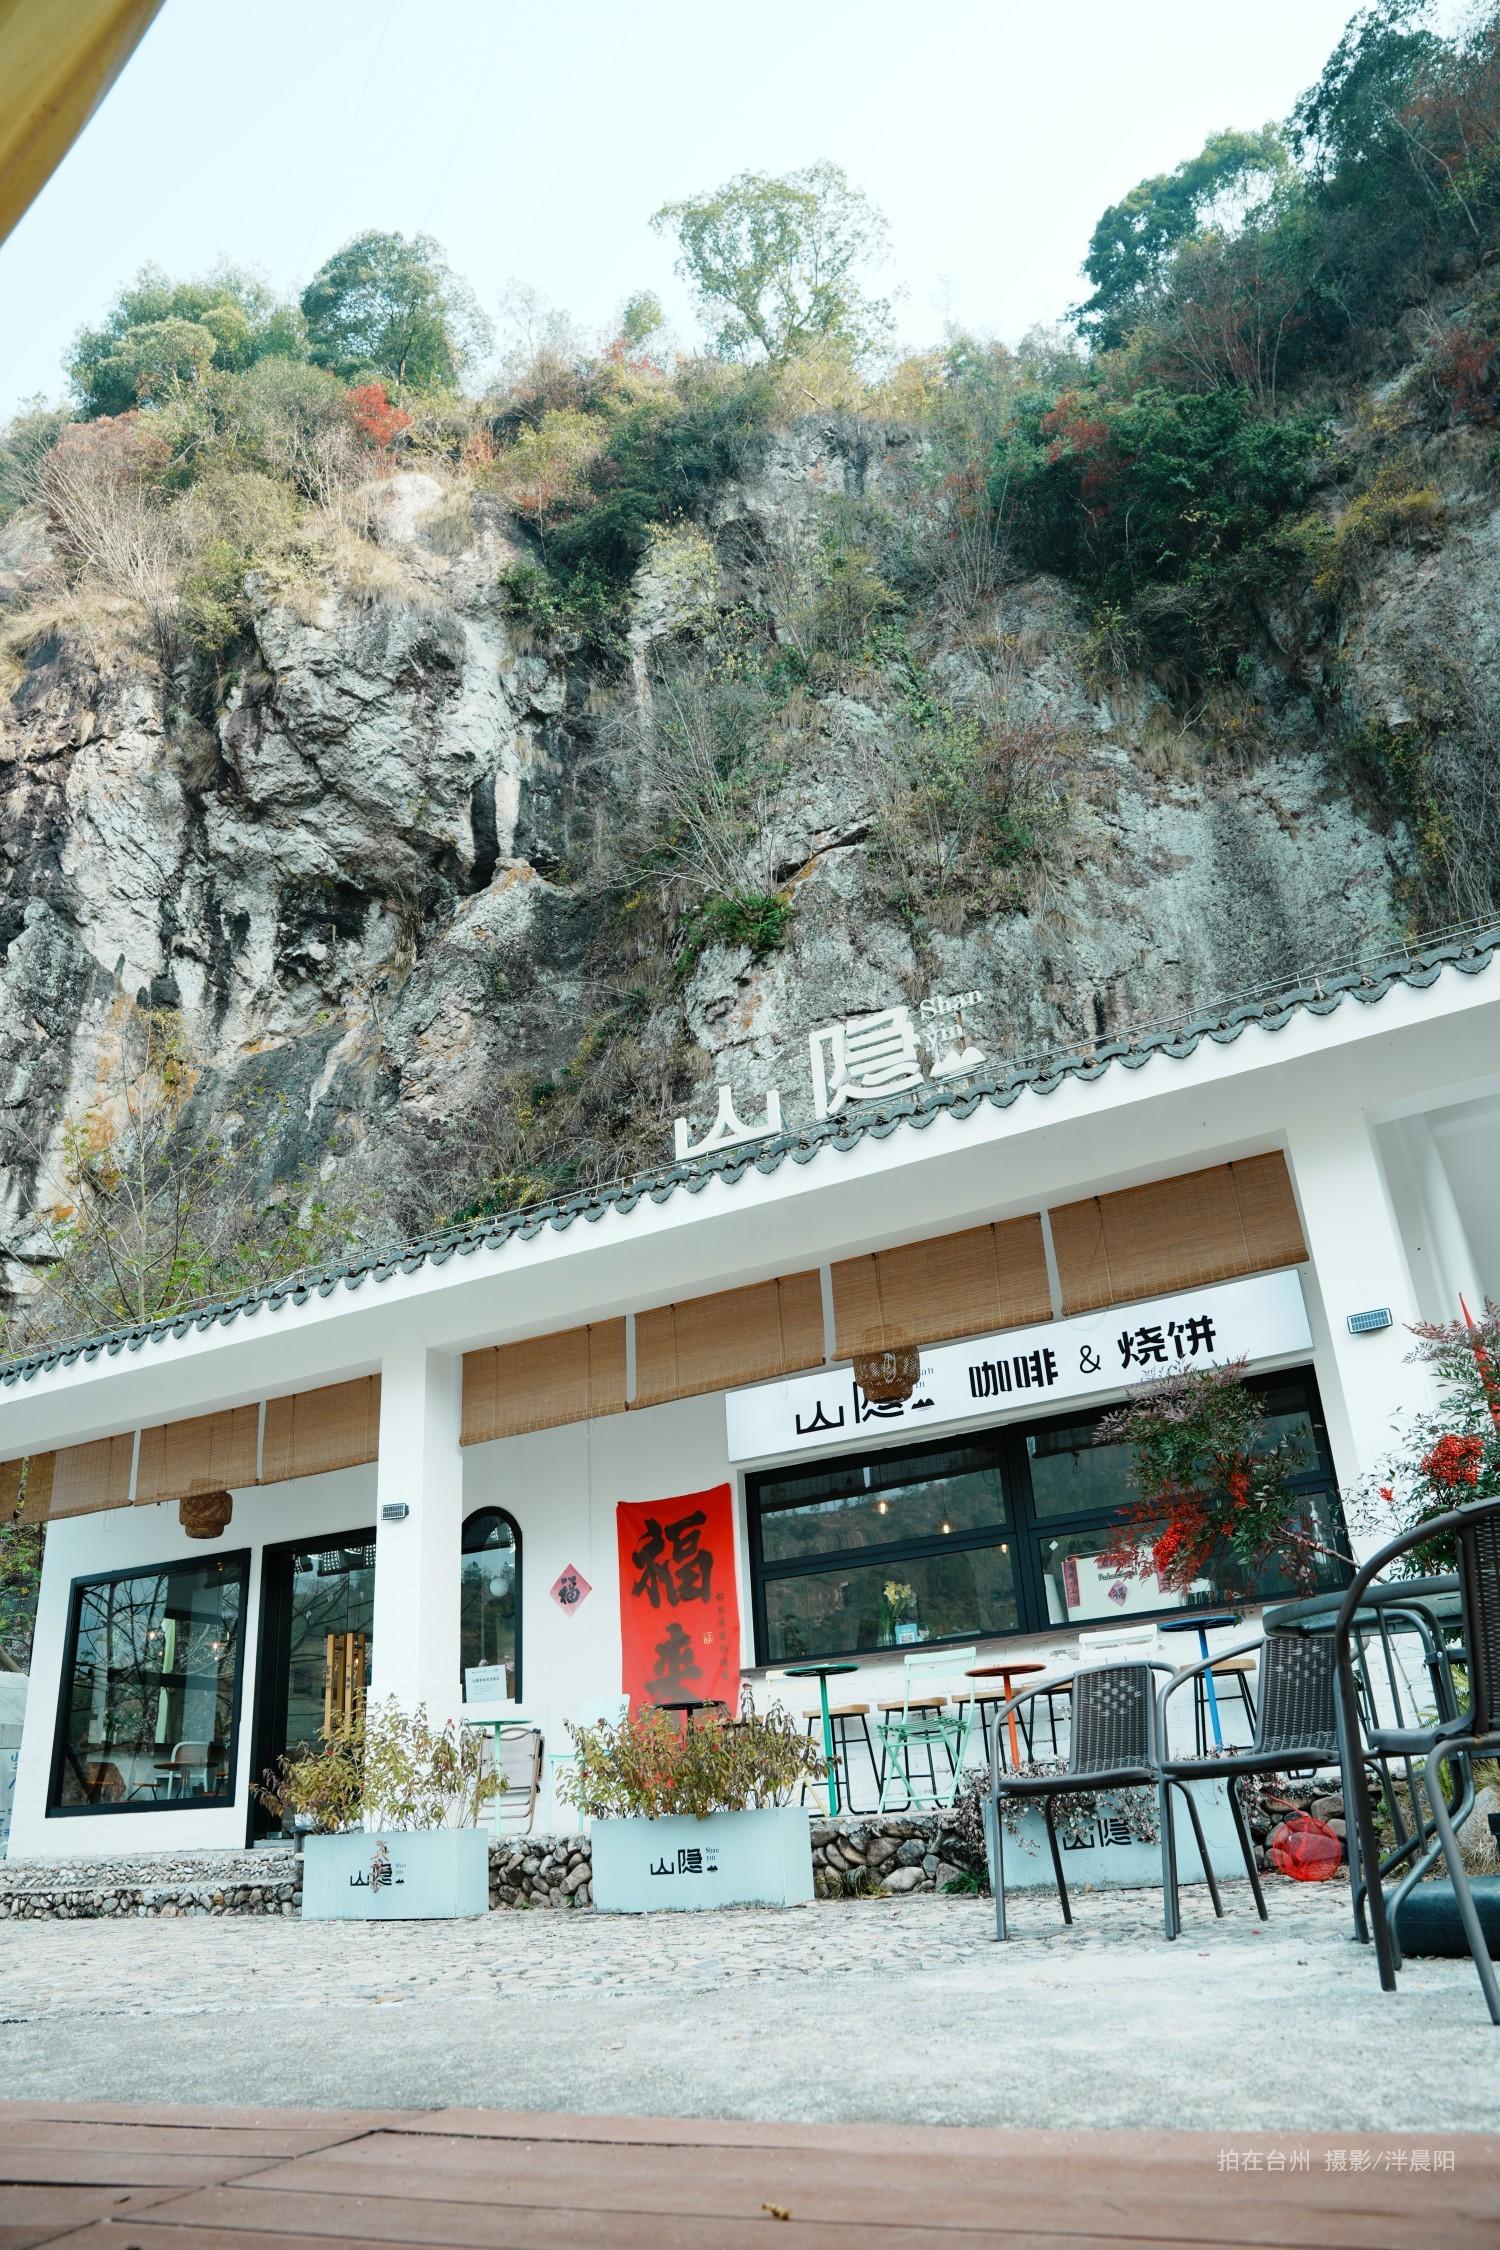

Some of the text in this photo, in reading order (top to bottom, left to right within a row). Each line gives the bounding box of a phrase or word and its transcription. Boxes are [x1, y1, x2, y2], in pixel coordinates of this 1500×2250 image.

[920, 990, 982, 1019] Shan
[925, 1022, 963, 1052] yin
[968, 1347, 1058, 1397] 咖啡
[1079, 1344, 1101, 1373] &
[1117, 1314, 1216, 1369] 烧饼
[558, 1575, 580, 1604] 福
[650, 1848, 703, 1875] 山隐
